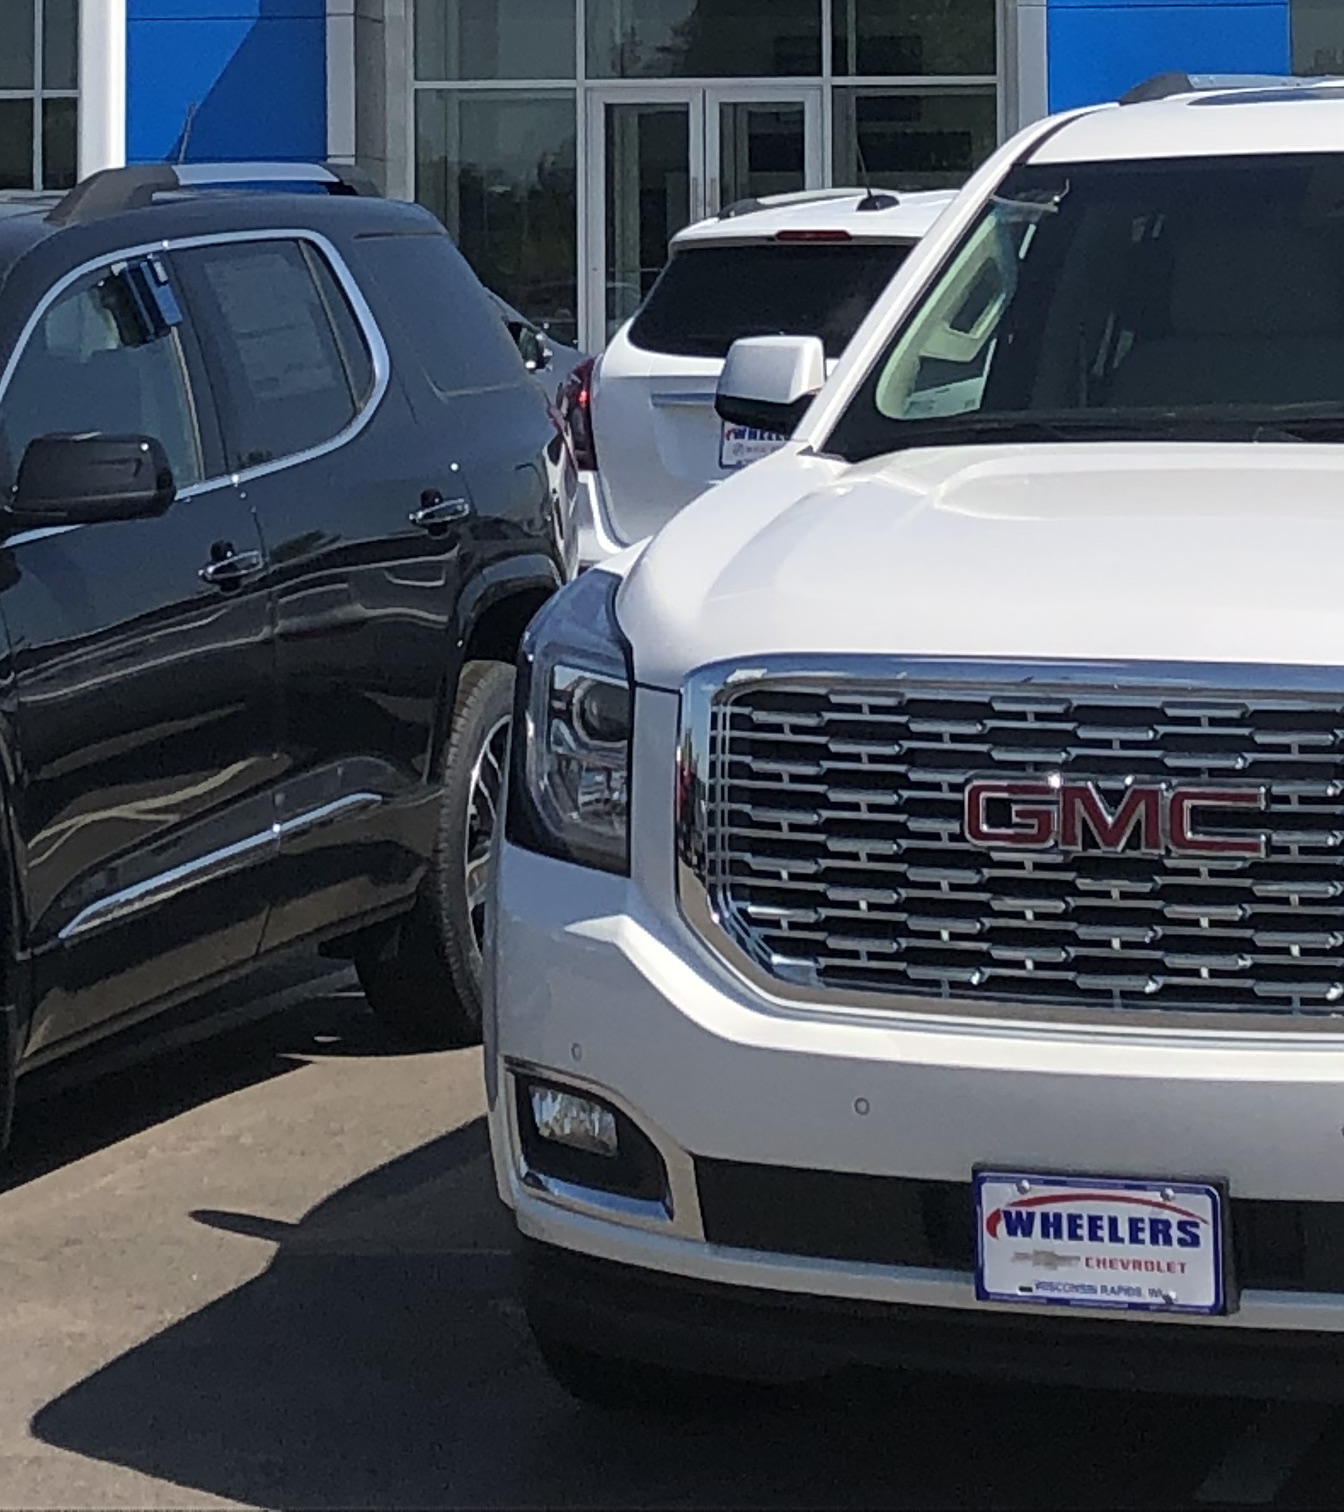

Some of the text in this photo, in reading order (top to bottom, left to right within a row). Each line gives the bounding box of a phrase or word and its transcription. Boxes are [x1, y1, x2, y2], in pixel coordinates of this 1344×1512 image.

[964, 779, 1269, 858] GMC
[1002, 1209, 1201, 1248] WHEELERS
[1085, 1255, 1188, 1274] CHEVROLET
